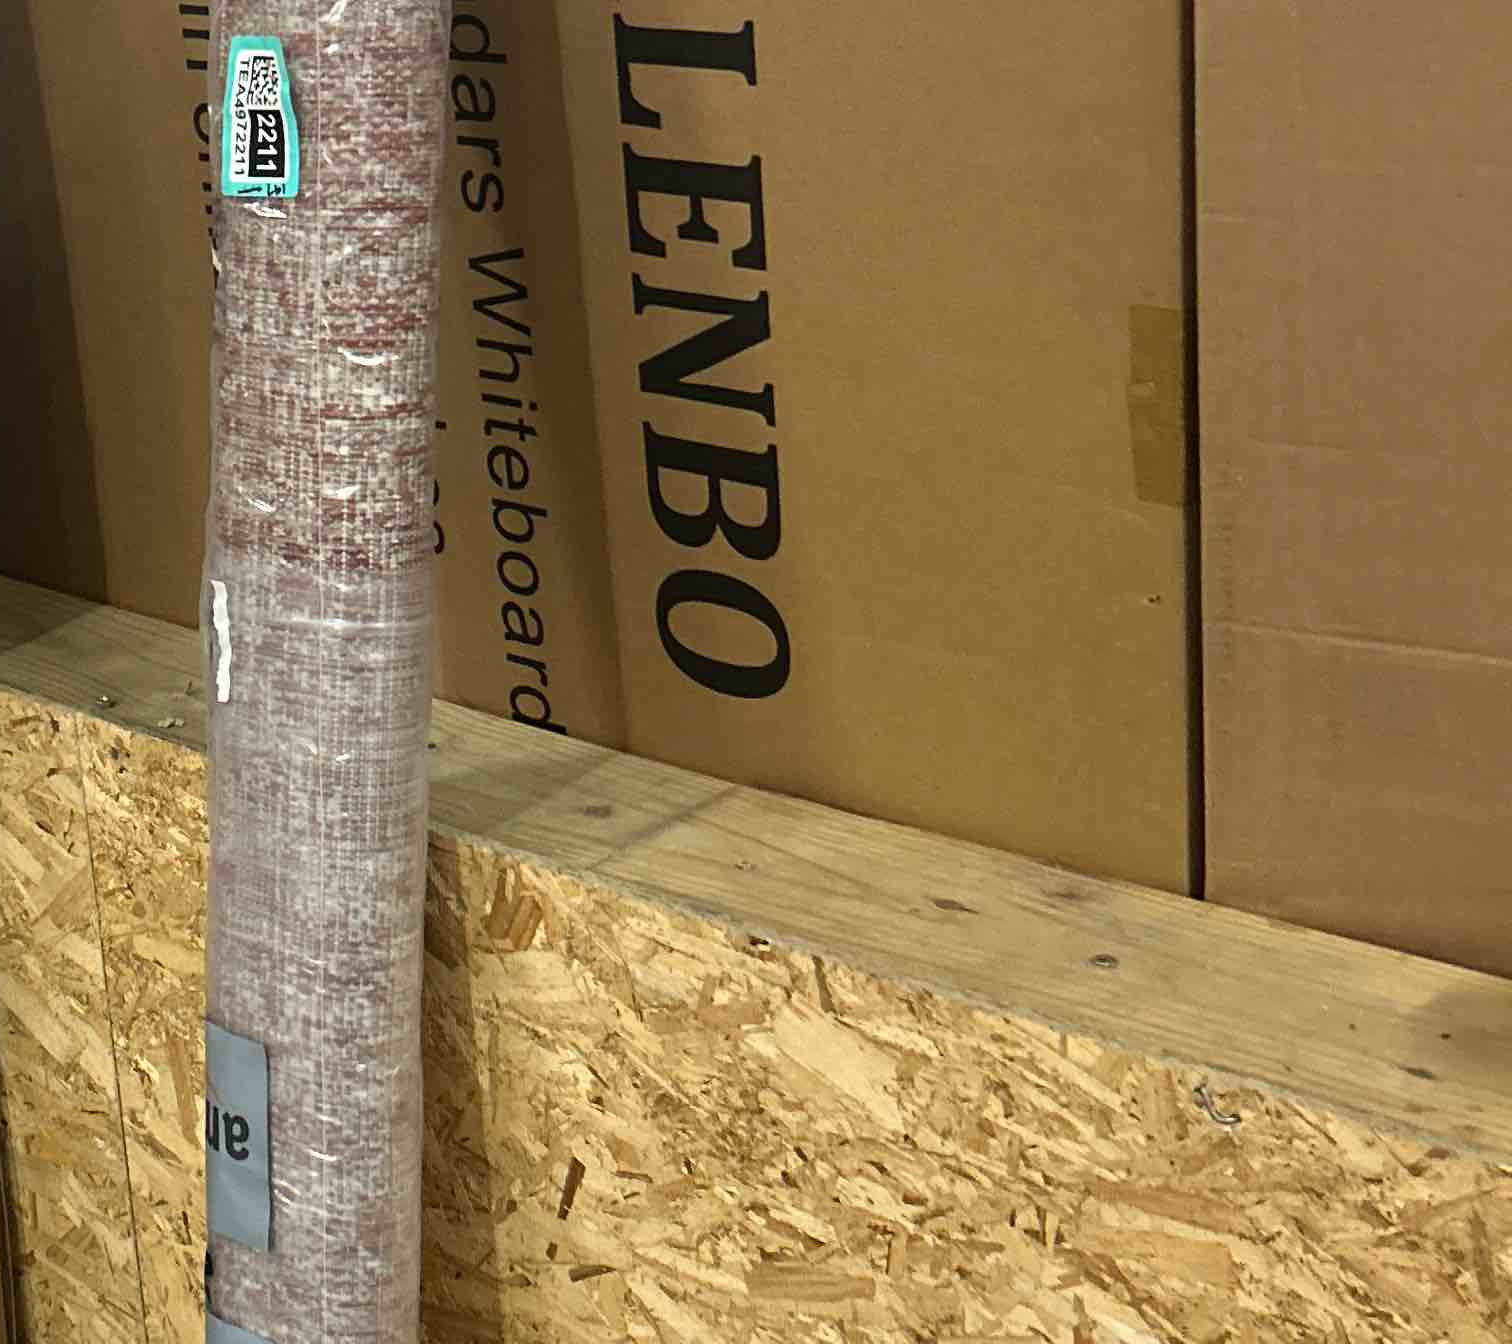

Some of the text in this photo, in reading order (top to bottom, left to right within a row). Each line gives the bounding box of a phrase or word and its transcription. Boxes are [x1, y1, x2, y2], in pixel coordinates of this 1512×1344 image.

[234, 60, 250, 175] TEA4972211
[255, 112, 279, 173] 2211
[468, 246, 569, 740] Whiteboard
